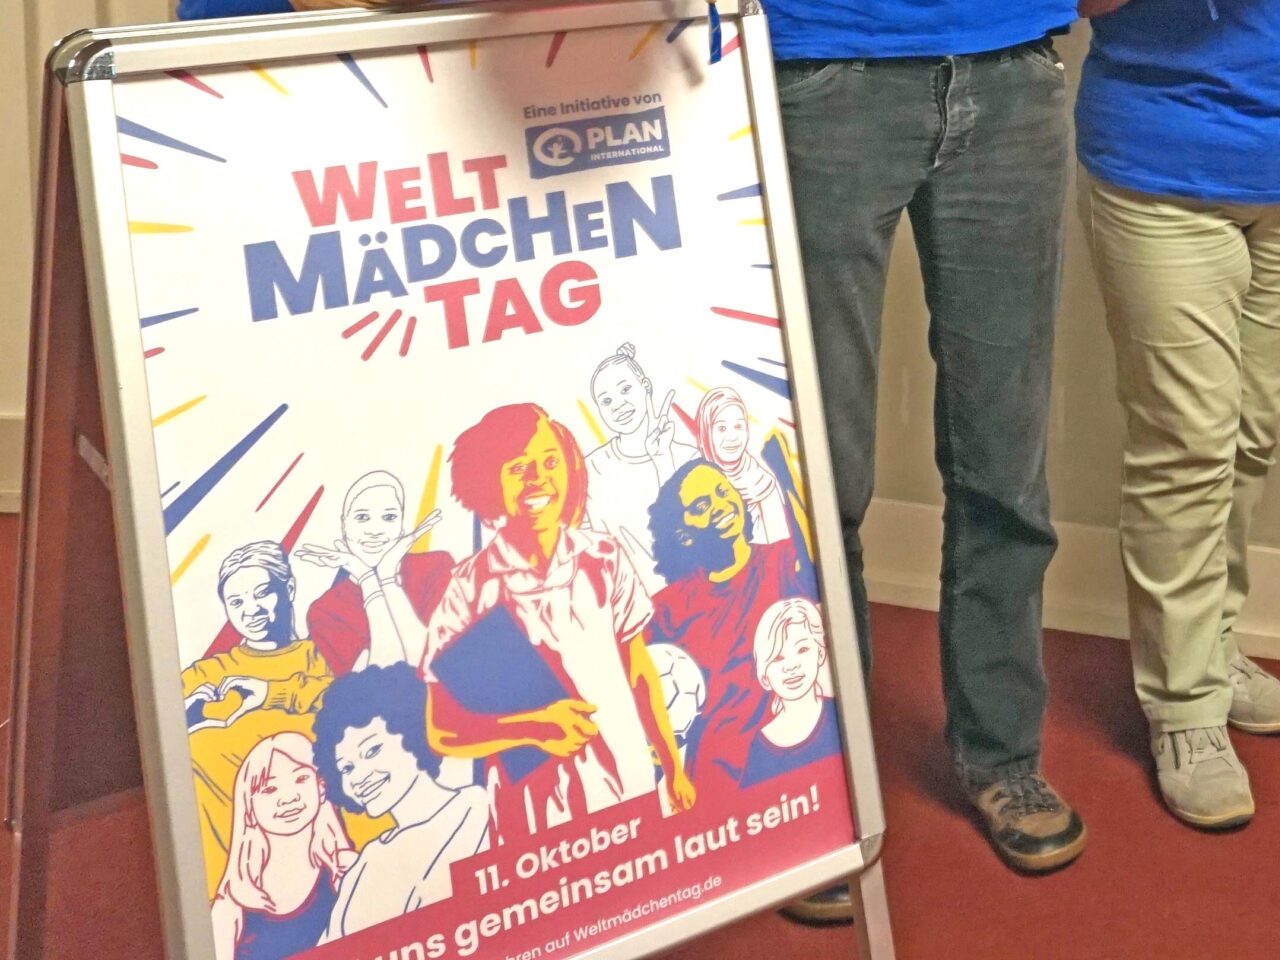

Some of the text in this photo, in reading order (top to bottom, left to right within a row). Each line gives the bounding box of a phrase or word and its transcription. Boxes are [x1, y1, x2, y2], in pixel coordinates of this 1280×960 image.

[523, 93, 662, 119] Eine Initiative von
[586, 119, 663, 150] PLAN
[291, 151, 507, 228] WELT
[591, 145, 664, 161] INTERNATIONAL
[243, 174, 683, 323] MÄDCHEN
[424, 260, 601, 350] TAG
[454, 848, 668, 957] gemeinsam
[674, 816, 741, 864] laut
[745, 784, 820, 836] sein!
[475, 816, 641, 895] 11. Oktober
[545, 934, 571, 954] auf
[573, 874, 722, 942] Weltmädchentag.de
